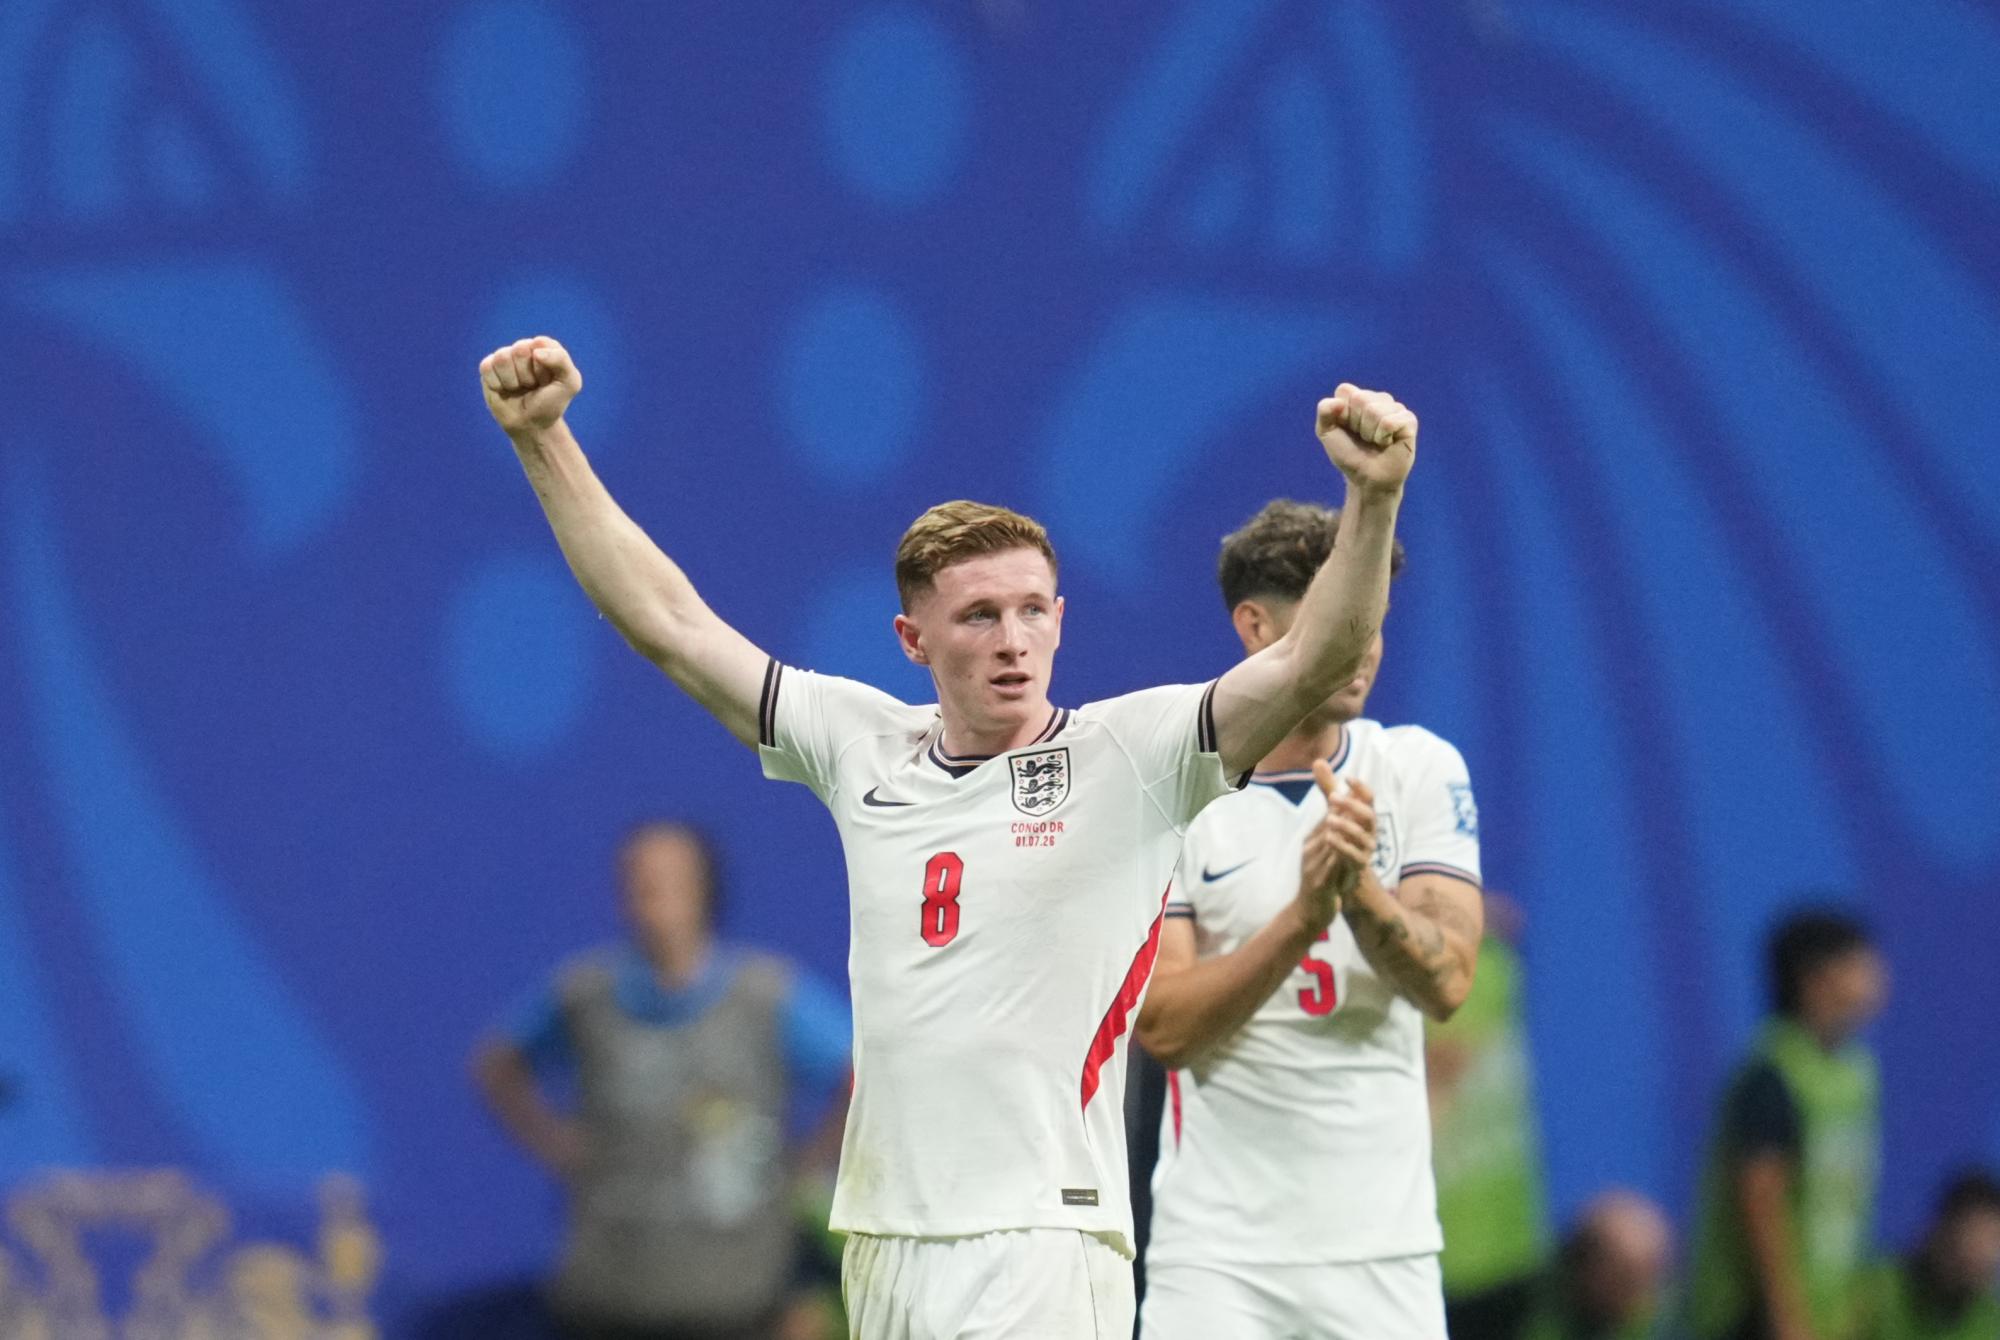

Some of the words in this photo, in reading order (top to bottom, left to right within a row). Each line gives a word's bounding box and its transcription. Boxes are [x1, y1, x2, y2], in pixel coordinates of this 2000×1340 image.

[1011, 822, 1047, 833] CONGO
[1049, 821, 1064, 832] DR
[1015, 835, 1055, 847] 01.07.26
[920, 852, 964, 947] 8
[1298, 928, 1337, 1017] 5
